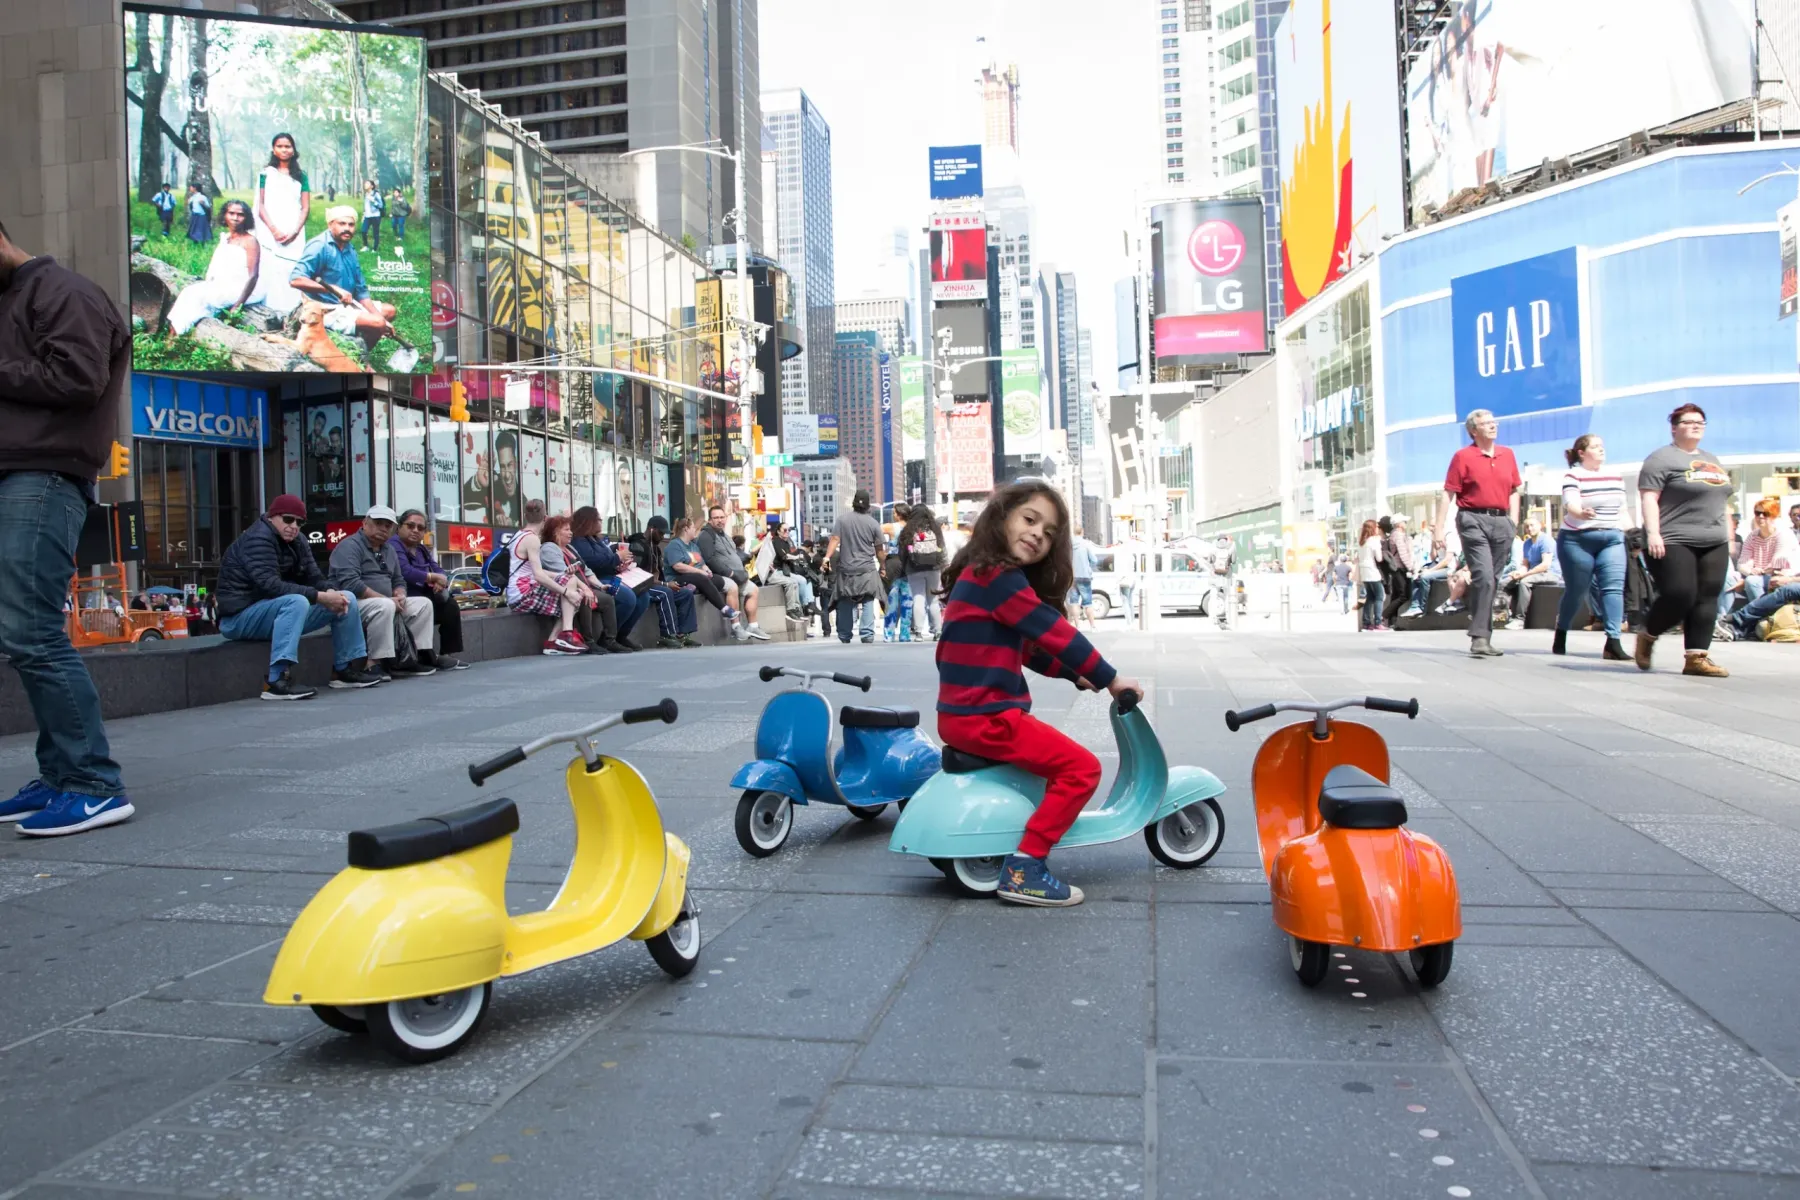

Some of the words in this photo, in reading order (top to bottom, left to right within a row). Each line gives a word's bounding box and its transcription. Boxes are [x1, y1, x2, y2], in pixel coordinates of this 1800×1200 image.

[298, 104, 382, 124] NATURE
[377, 255, 413, 271] kerala
[943, 284, 976, 293] XINHUA
[1194, 279, 1244, 313] LG
[1476, 299, 1551, 377] GAP
[938, 345, 984, 357] SMSUNG
[395, 459, 425, 475] LADIES
[437, 471, 458, 484] VINNY
